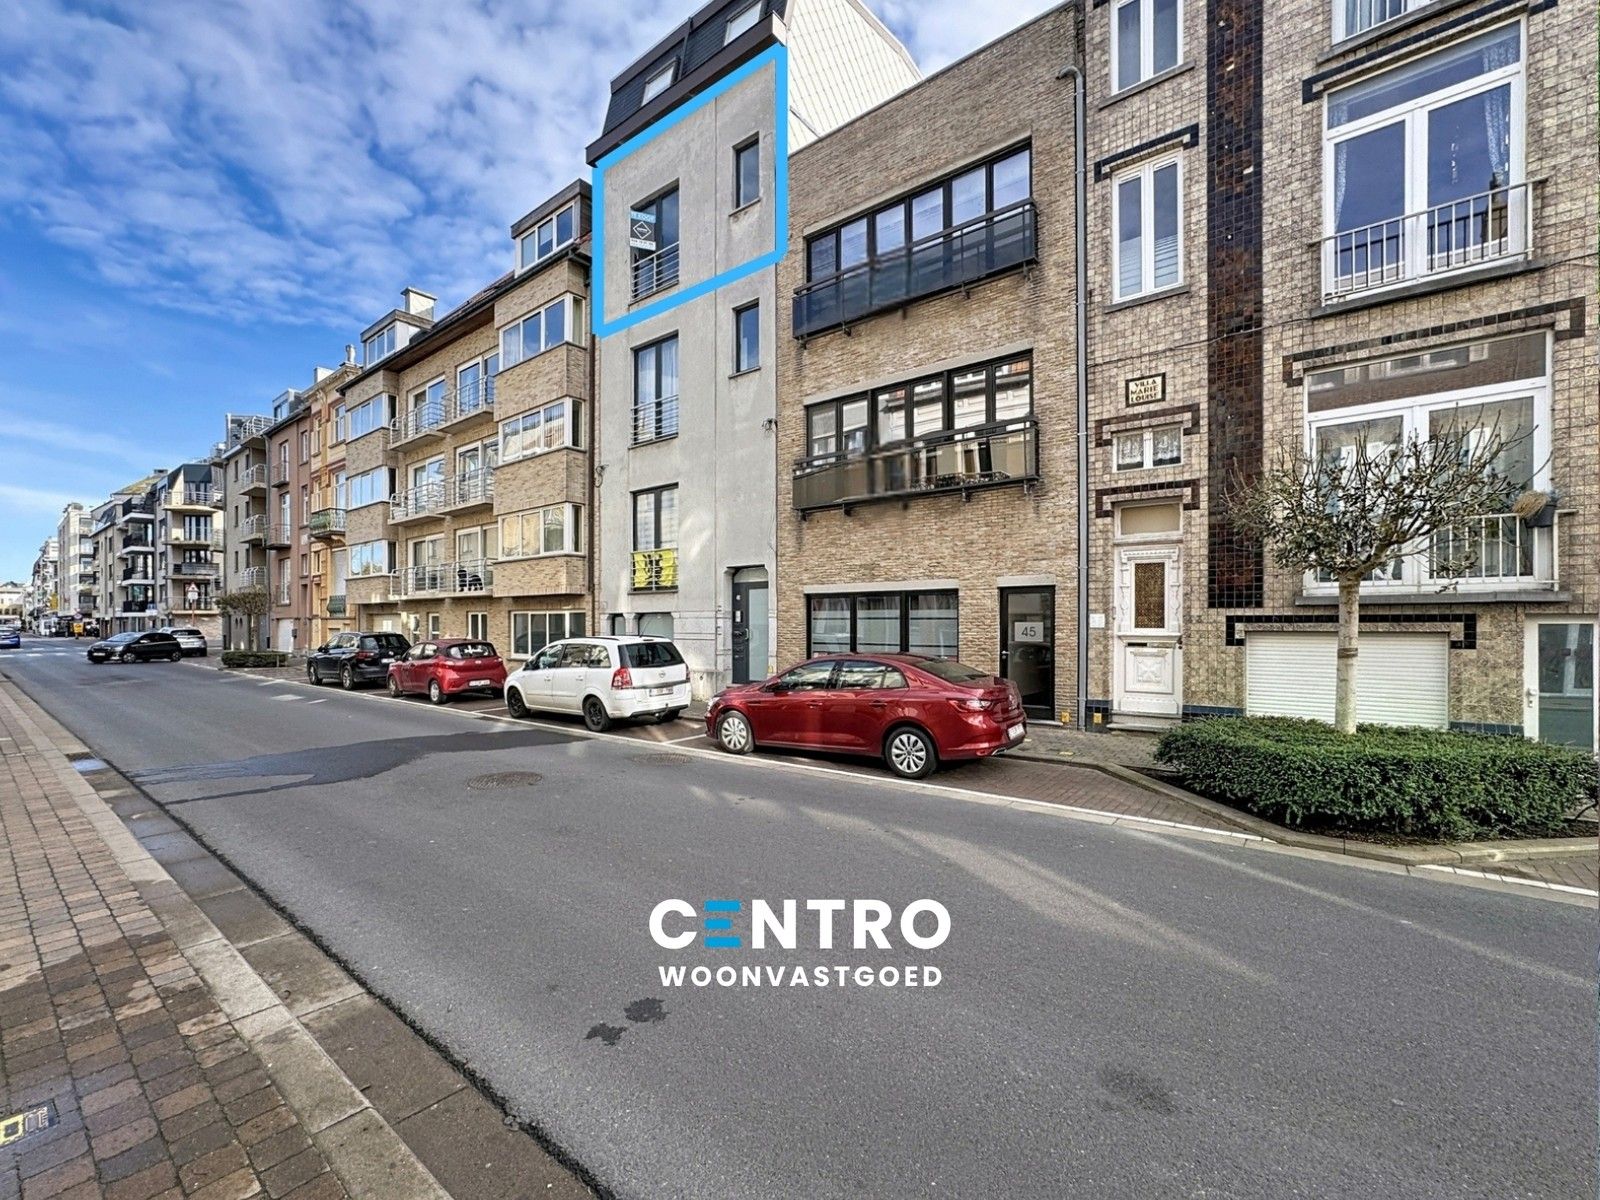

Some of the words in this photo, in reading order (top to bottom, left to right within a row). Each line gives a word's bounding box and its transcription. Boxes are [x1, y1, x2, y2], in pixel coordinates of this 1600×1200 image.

[1134, 379, 1157, 387] VILLA
[1130, 386, 1157, 395] MARIE
[1130, 393, 1157, 402] LOUISE
[1021, 626, 1037, 637] 45
